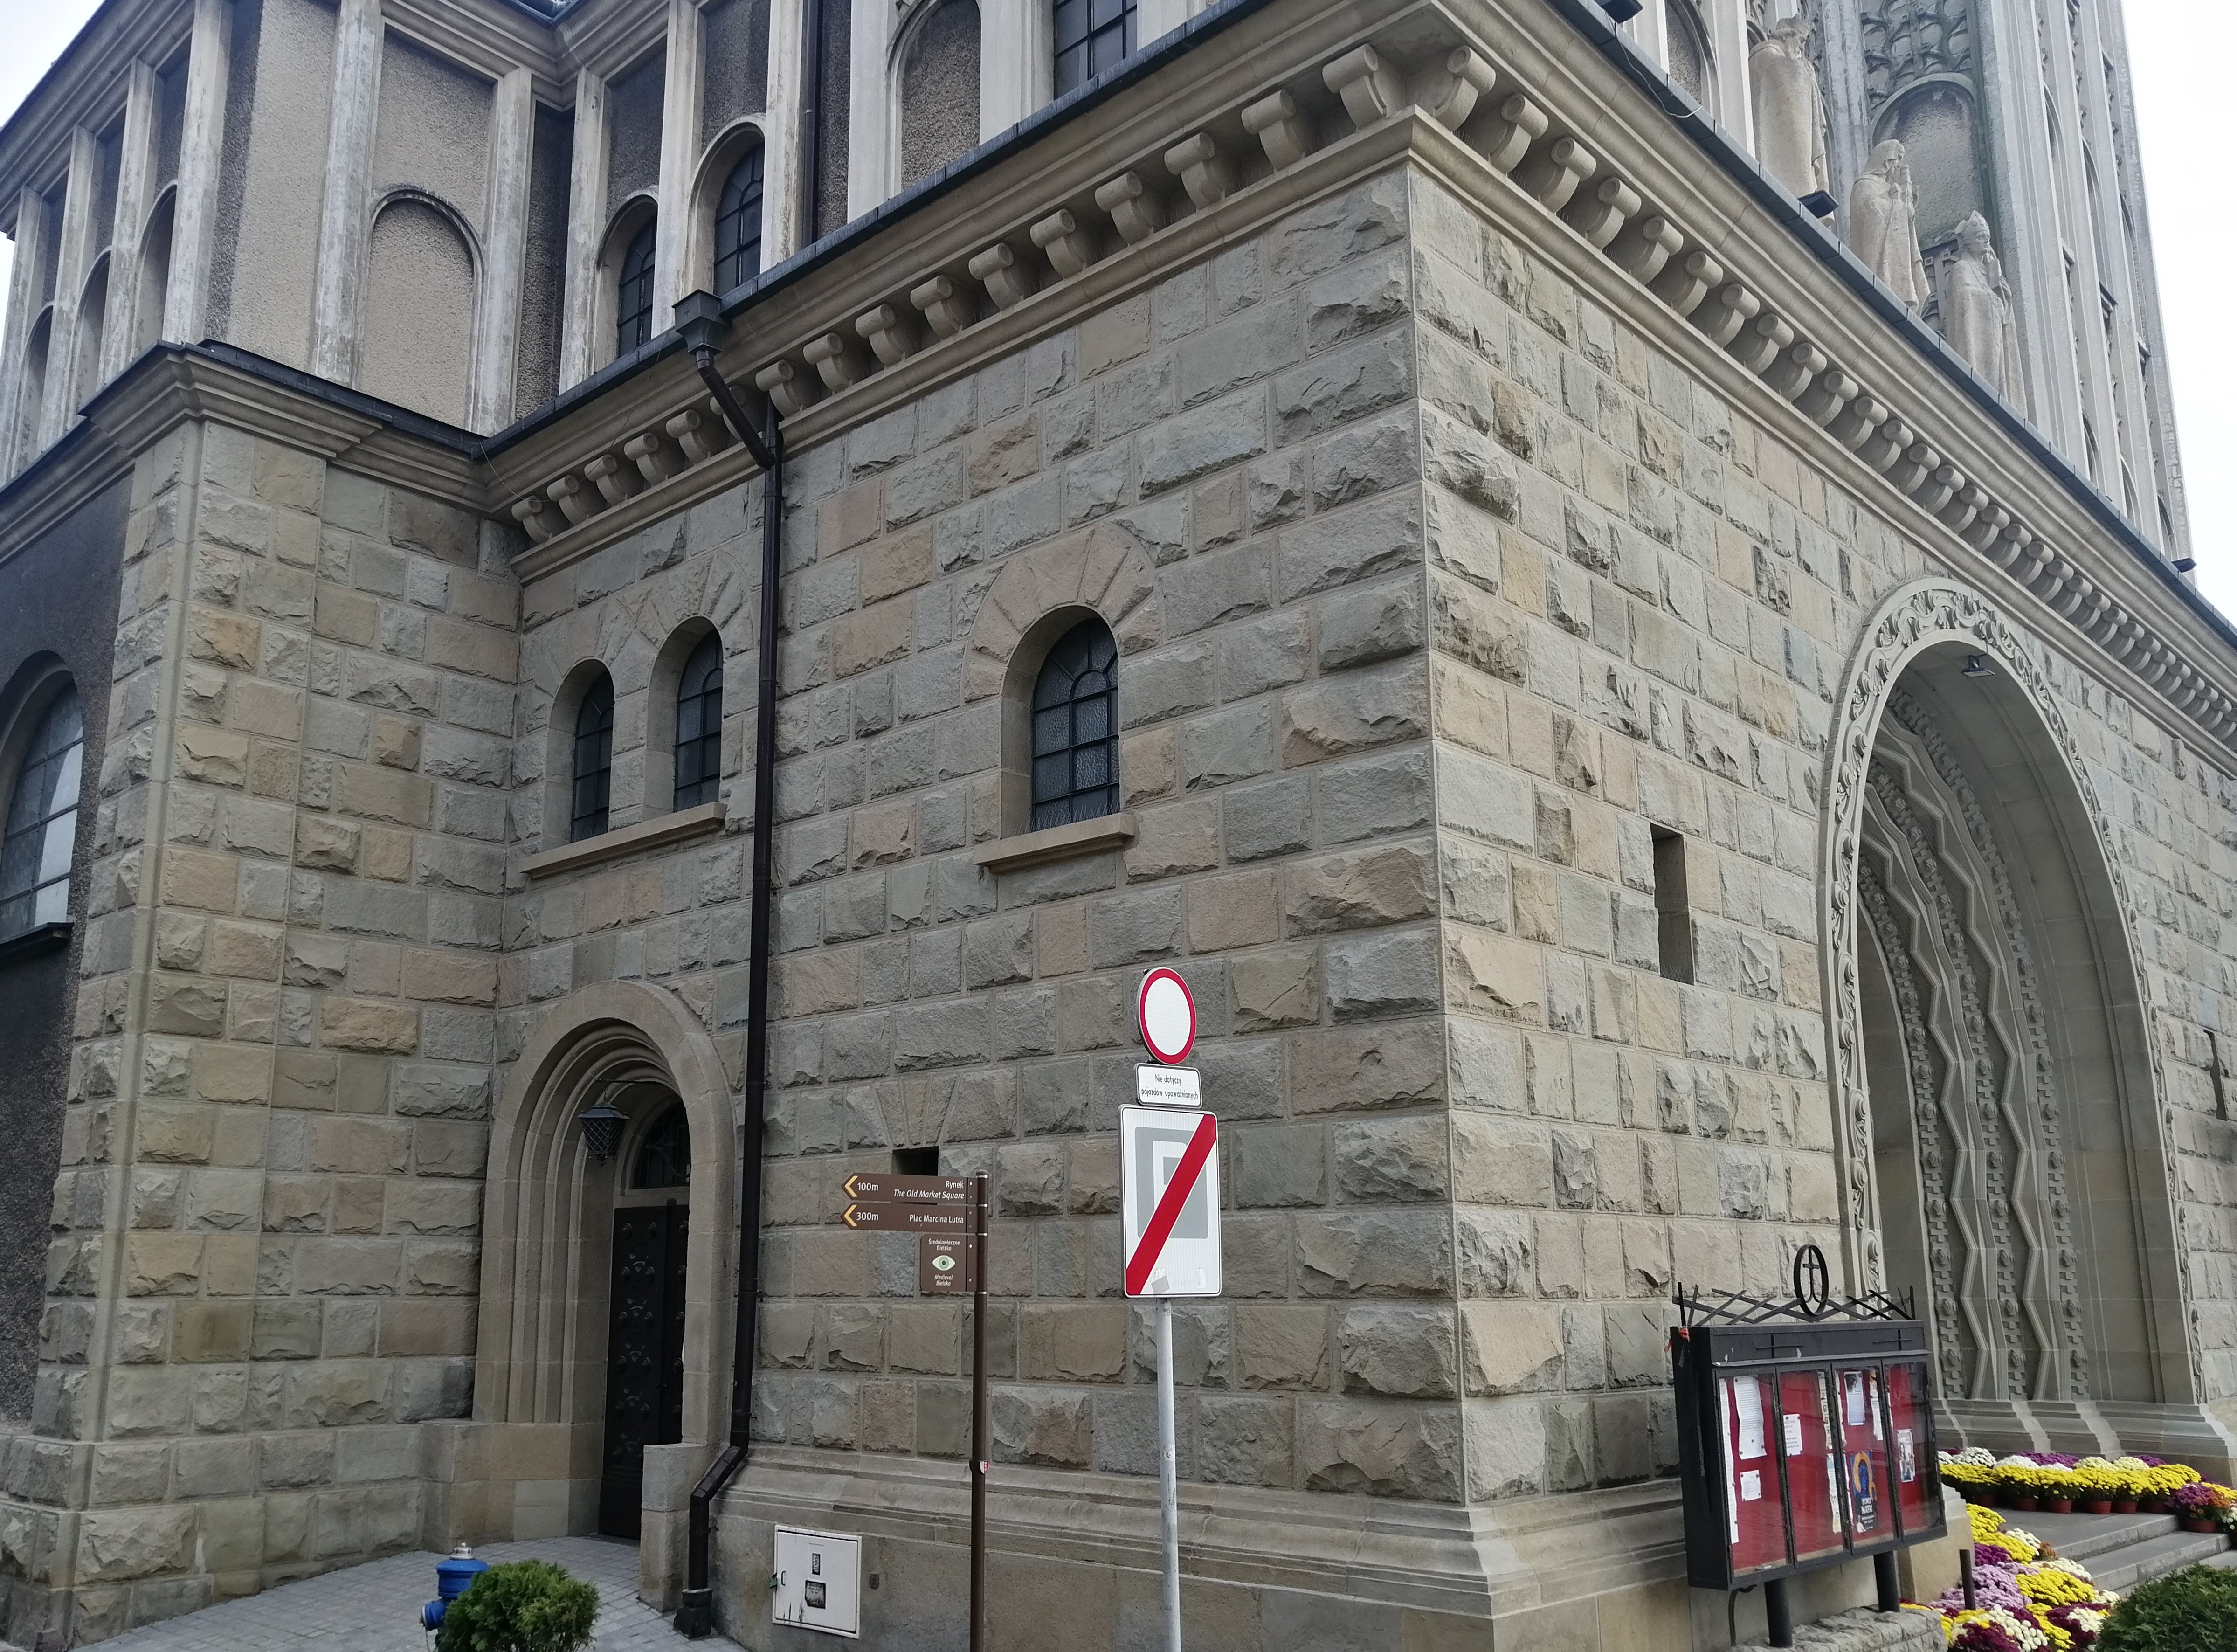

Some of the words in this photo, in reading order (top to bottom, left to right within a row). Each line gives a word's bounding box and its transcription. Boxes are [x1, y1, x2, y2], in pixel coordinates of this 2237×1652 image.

[1164, 1075, 1181, 1086] dotyczy
[1141, 1087, 1162, 1097] pojazdów
[1165, 1090, 1198, 1100] upoważnionych
[857, 1182, 878, 1191] 100m
[946, 1180, 964, 1189] Rynek
[942, 1191, 964, 1200] Square
[856, 1212, 878, 1220] 300m
